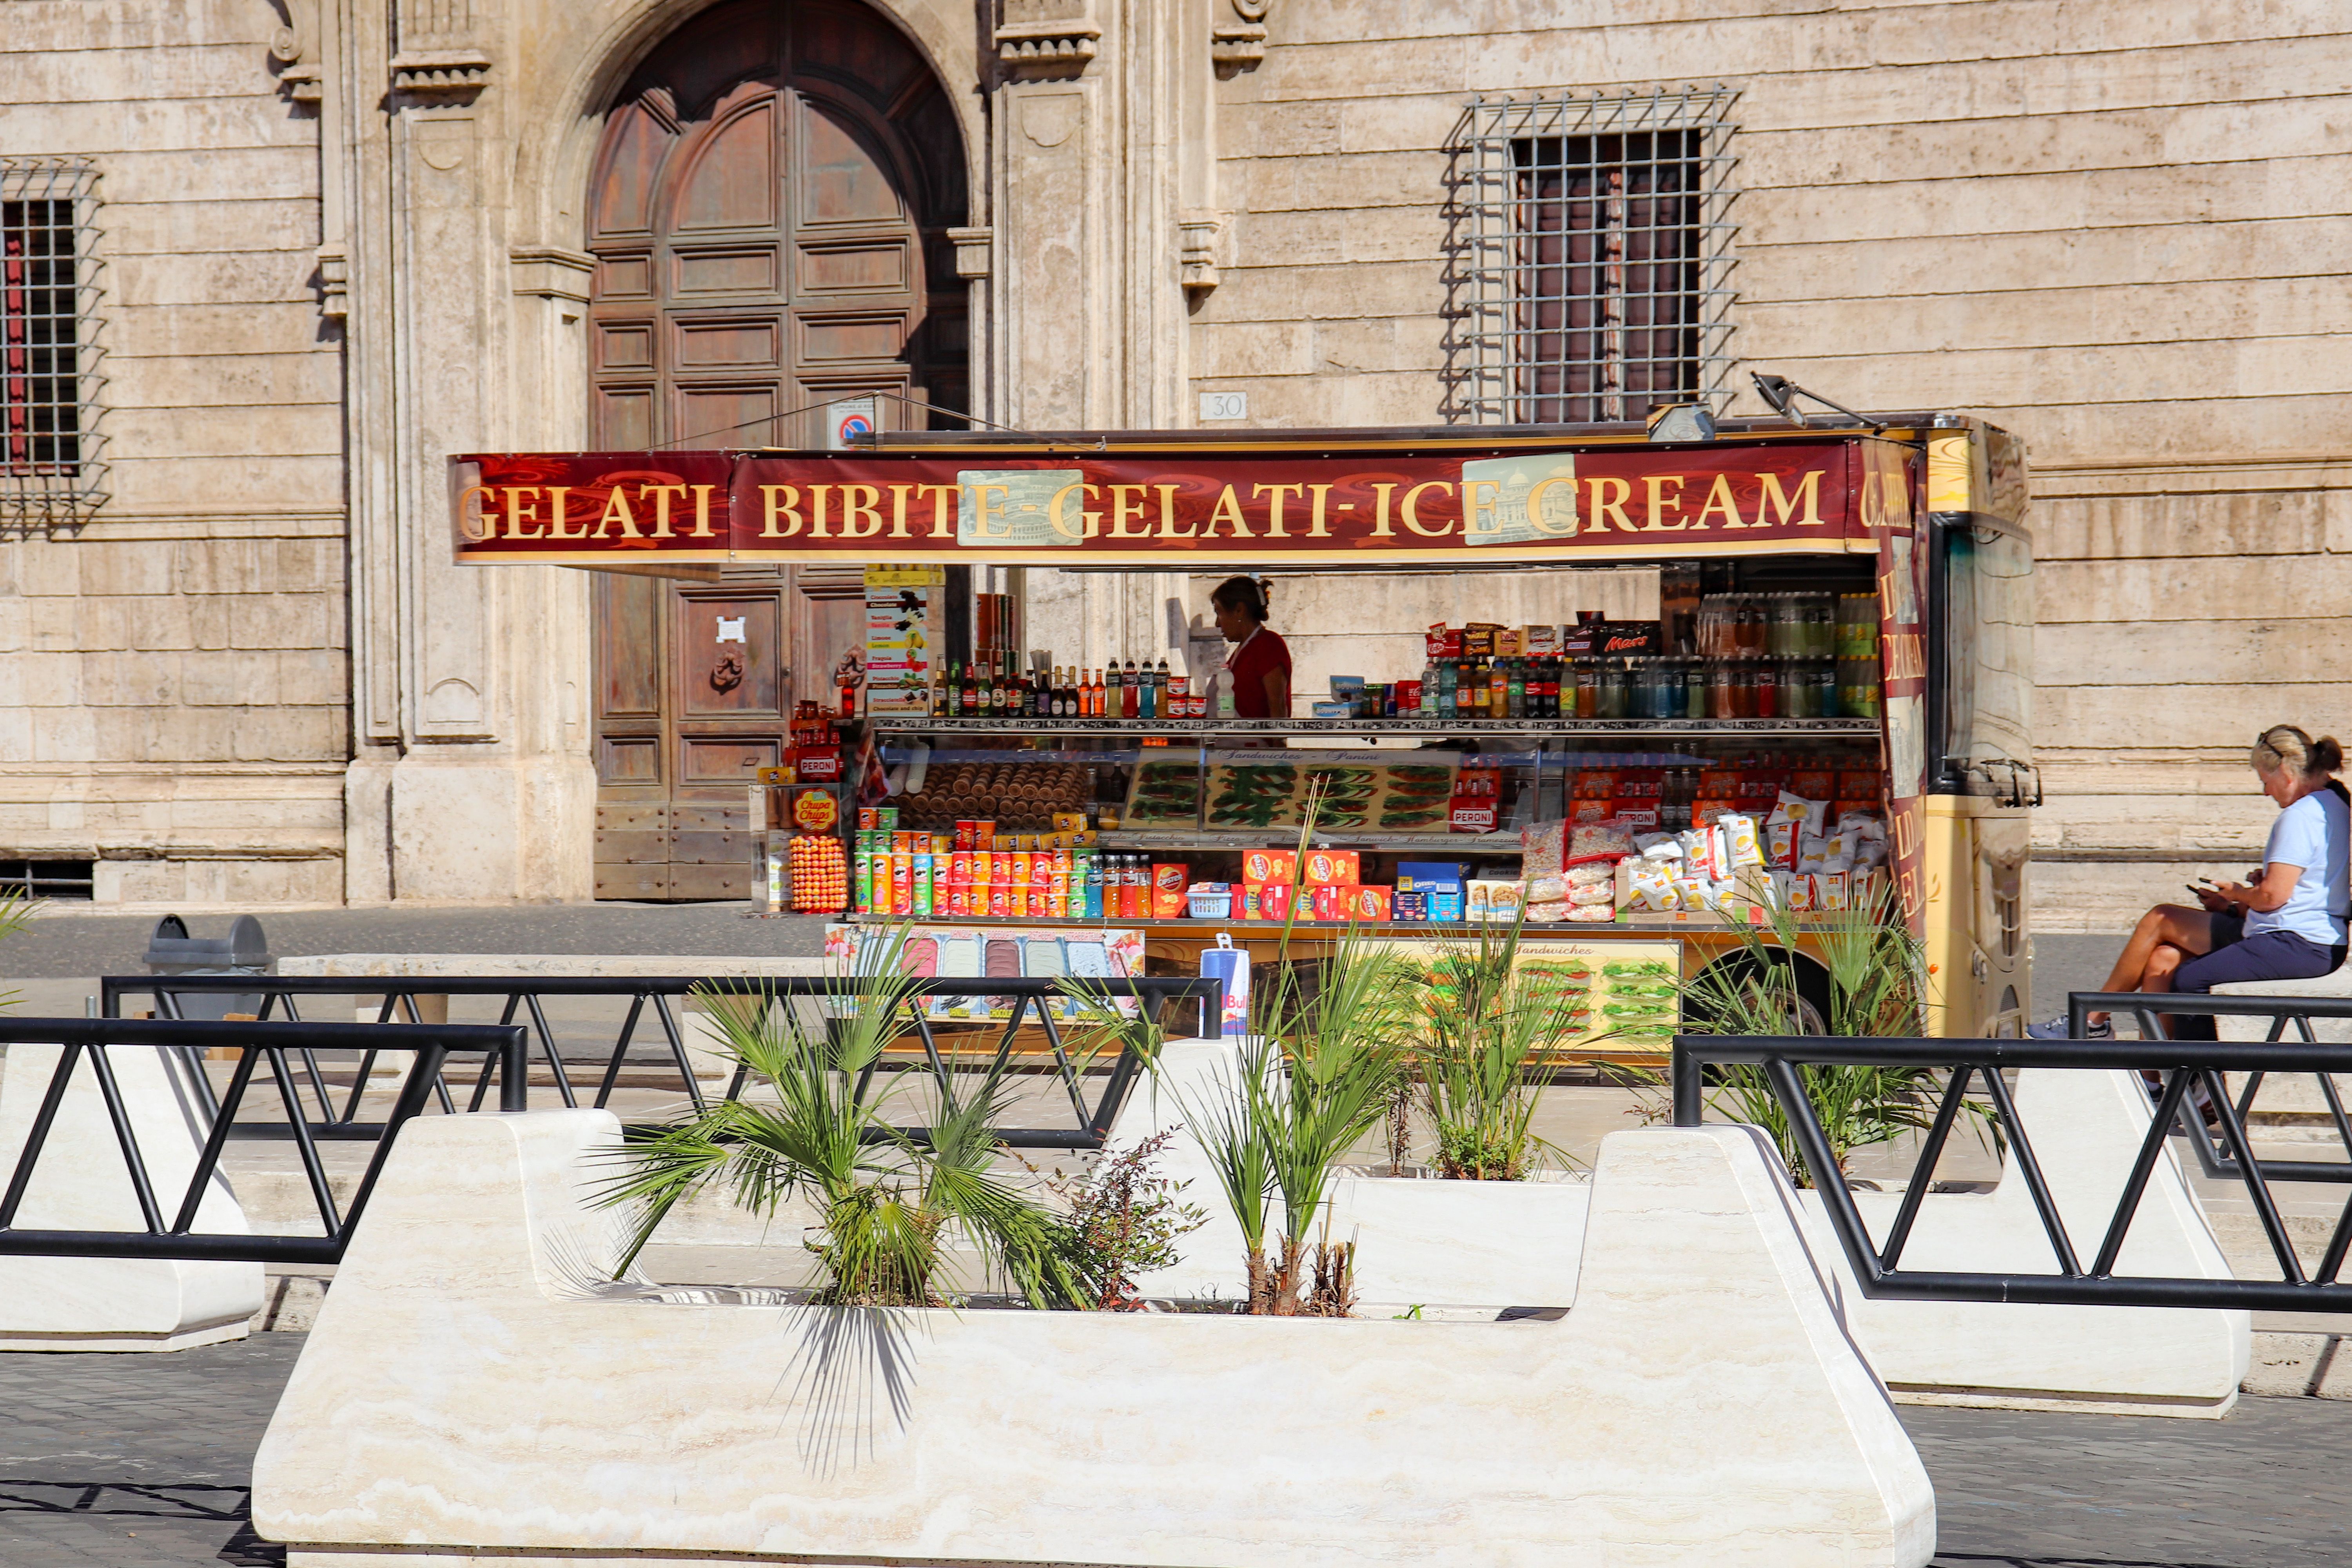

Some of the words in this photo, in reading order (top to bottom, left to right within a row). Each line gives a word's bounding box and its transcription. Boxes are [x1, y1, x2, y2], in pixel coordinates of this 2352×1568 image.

[1214, 395, 1241, 416] 30
[1526, 468, 1826, 535] CREAM
[459, 483, 717, 540] GELATI
[1604, 636, 1648, 652] Mars
[1218, 749, 1303, 760] Sandwiches
[1326, 749, 1380, 761] Panini
[802, 762, 833, 770] PERONI
[801, 800, 831, 812] Chupa
[800, 810, 830, 820] Chups
[1455, 813, 1492, 823] PERONI
[1252, 854, 1267, 881] CIPSTER
[1156, 874, 1183, 887] CIPSTER
[1247, 892, 1258, 912] RITZ
[1300, 892, 1311, 913] RITZ
